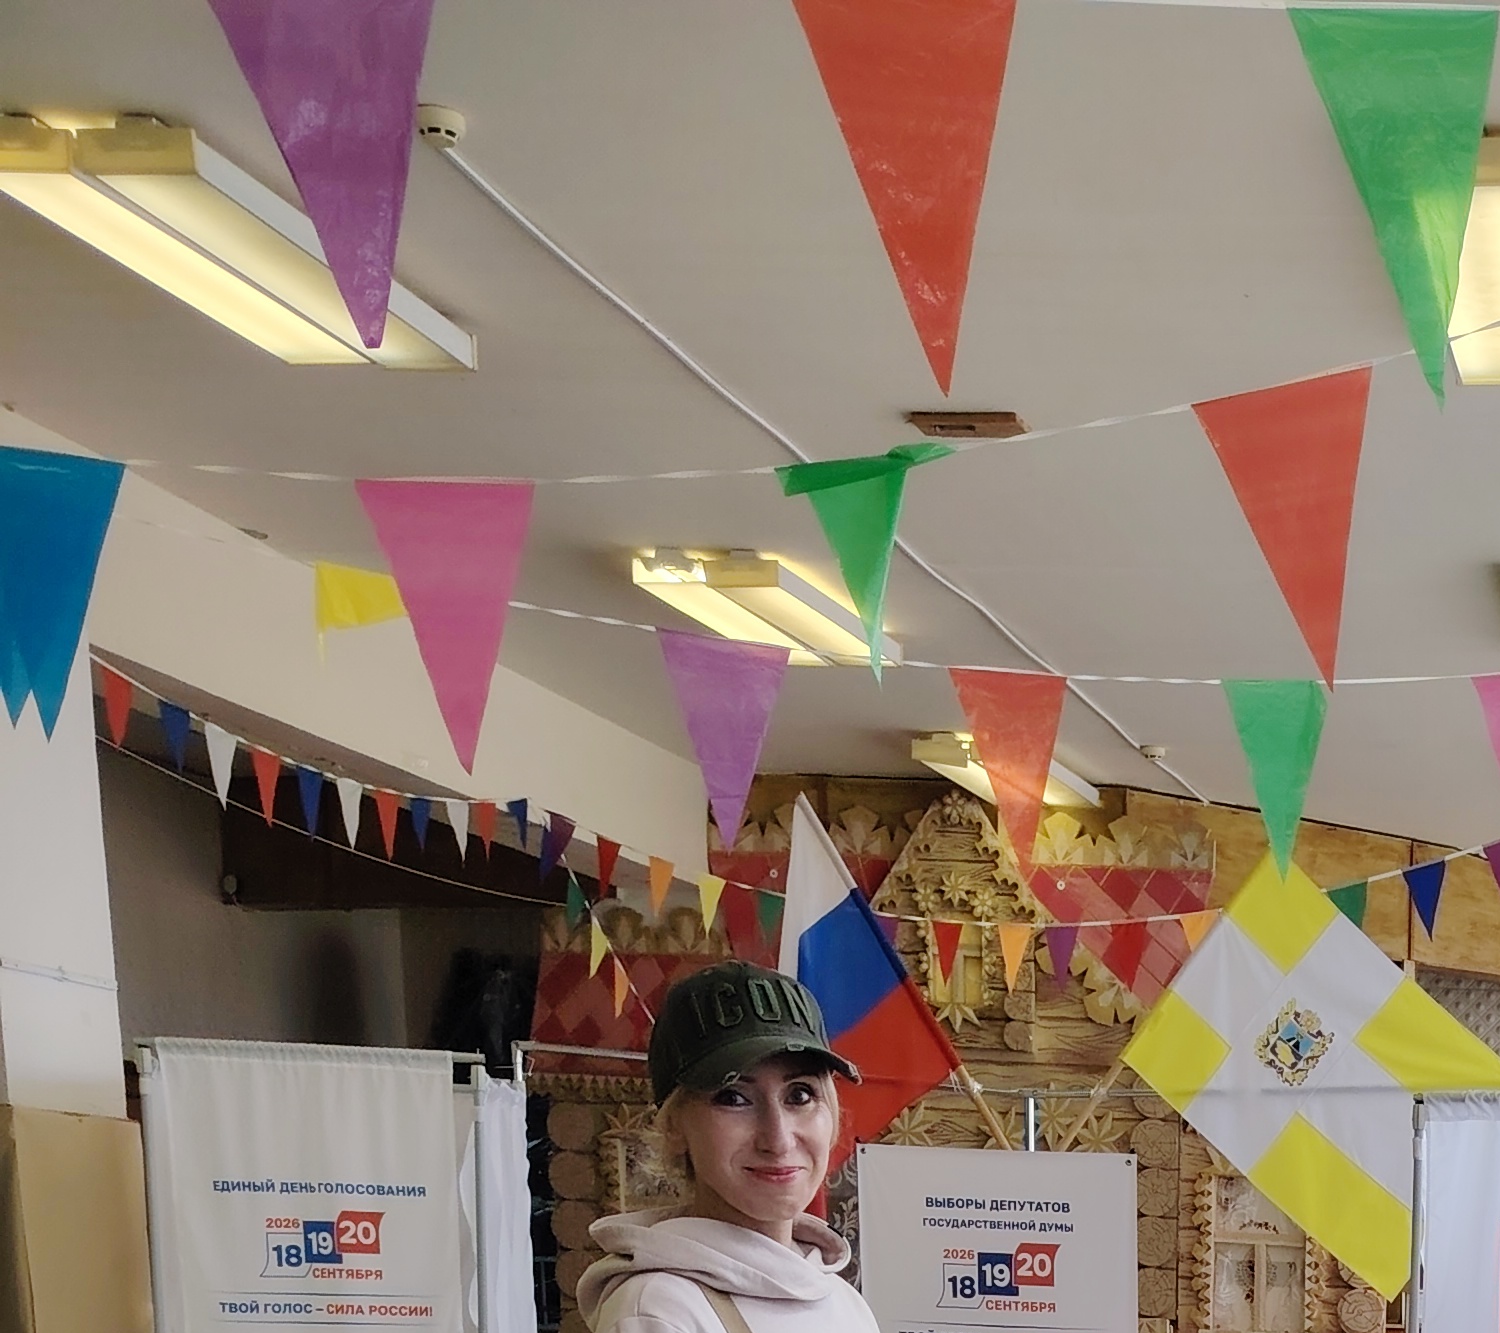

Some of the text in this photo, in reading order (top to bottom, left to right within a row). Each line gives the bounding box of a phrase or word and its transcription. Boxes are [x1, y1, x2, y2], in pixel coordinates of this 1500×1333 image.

[690, 977, 816, 1039] ICON
[213, 1179, 427, 1197] ЕДИНЫЙ ДЕНЬ ГОЛОСОВАНИЯ
[925, 1197, 1071, 1214] ВЫБОРЫ ДЕПУТАТОВ
[265, 1217, 300, 1229] 2026
[922, 1217, 1074, 1234] ГОСУДАРСТВЕННОЙ ДУМЫ
[272, 1220, 376, 1267] 18 19 20
[943, 1249, 975, 1260] 2026
[312, 1268, 383, 1280] СЕНТЯБРЯ
[948, 1252, 1052, 1299] 18 19 20
[219, 1301, 259, 1314] ТВОЙ
[263, 1302, 313, 1315] ГОЛОС
[326, 1303, 365, 1316] СИЛА
[368, 1305, 433, 1317] РОССИИ!
[985, 1299, 1056, 1313] СЕНТЯБРЯ
